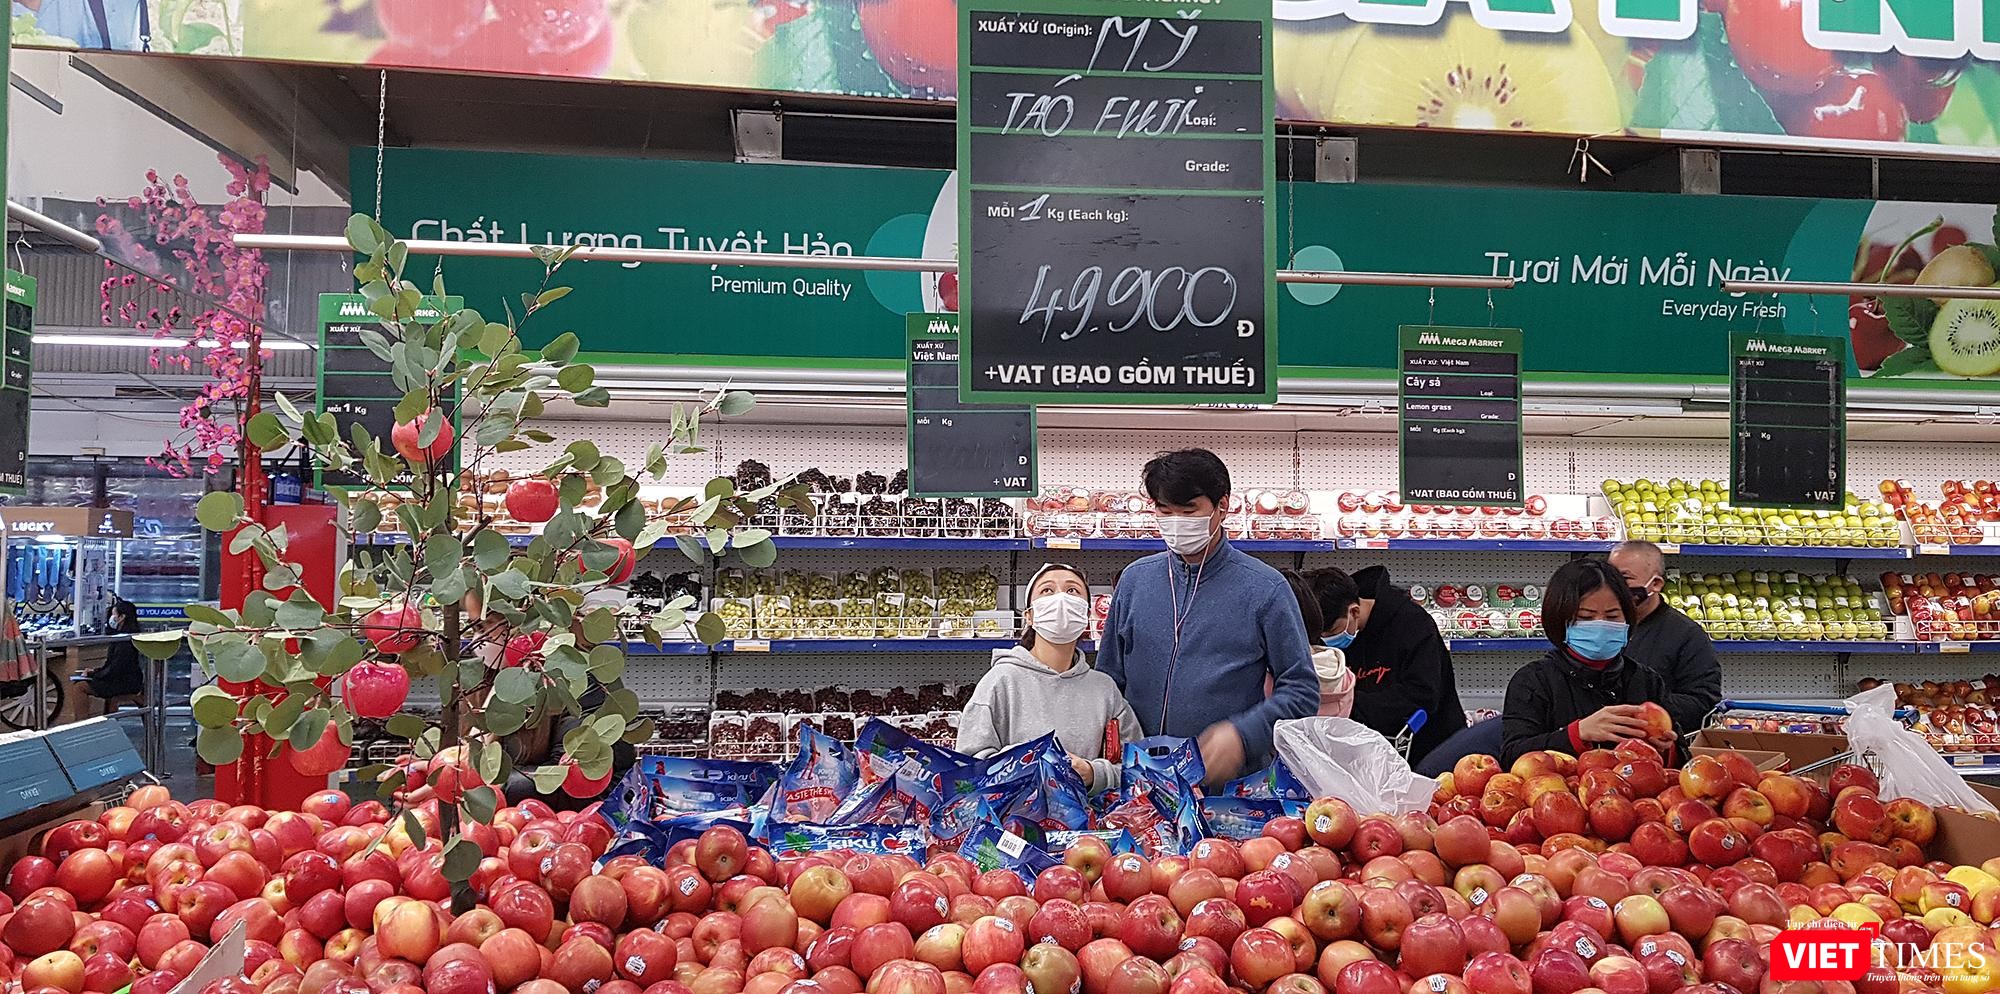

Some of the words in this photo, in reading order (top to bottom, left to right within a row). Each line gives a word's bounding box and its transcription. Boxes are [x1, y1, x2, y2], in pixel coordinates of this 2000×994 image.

[978, 17, 1015, 33] XUẤT
[1019, 20, 1039, 33] XỨ
[1043, 22, 1093, 36] (Origin):
[1185, 160, 1230, 173] Grade:
[987, 201, 1015, 218] MỖI
[1018, 194, 1050, 222] 1
[1047, 208, 1065, 222] Kg
[1068, 208, 1103, 222] (Each
[1106, 209, 1129, 223] kg):
[1484, 252, 1560, 283] Tươi
[1572, 254, 1629, 286] Mới
[1640, 251, 1697, 287] Mỗi
[711, 275, 787, 296] Premium
[792, 278, 852, 301] Quality
[1018, 264, 1237, 344] 49.900
[1662, 299, 1738, 321] Everyday
[1743, 301, 1787, 318] Fresh
[1236, 320, 1255, 338] Đ
[913, 351, 935, 362] Việt
[937, 352, 960, 361] Nam
[1440, 358, 1454, 367] Việt
[984, 364, 1046, 384] +VAT
[1052, 364, 1112, 385] (BAO
[1118, 356, 1175, 386] GỒM
[1183, 357, 1256, 387] THUẾ)
[343, 403, 350, 412] 1
[354, 406, 367, 415] Kg
[1405, 403, 1430, 411] Lemon
[1431, 404, 1452, 412] grass
[941, 418, 953, 426] Kg
[1003, 477, 1027, 487] VAT
[1409, 489, 1435, 498] +VAT
[1436, 489, 1460, 498] (BAO
[1814, 490, 1836, 500] VAT
[12, 521, 55, 532] LUCKY
[827, 837, 877, 850] KIKU
